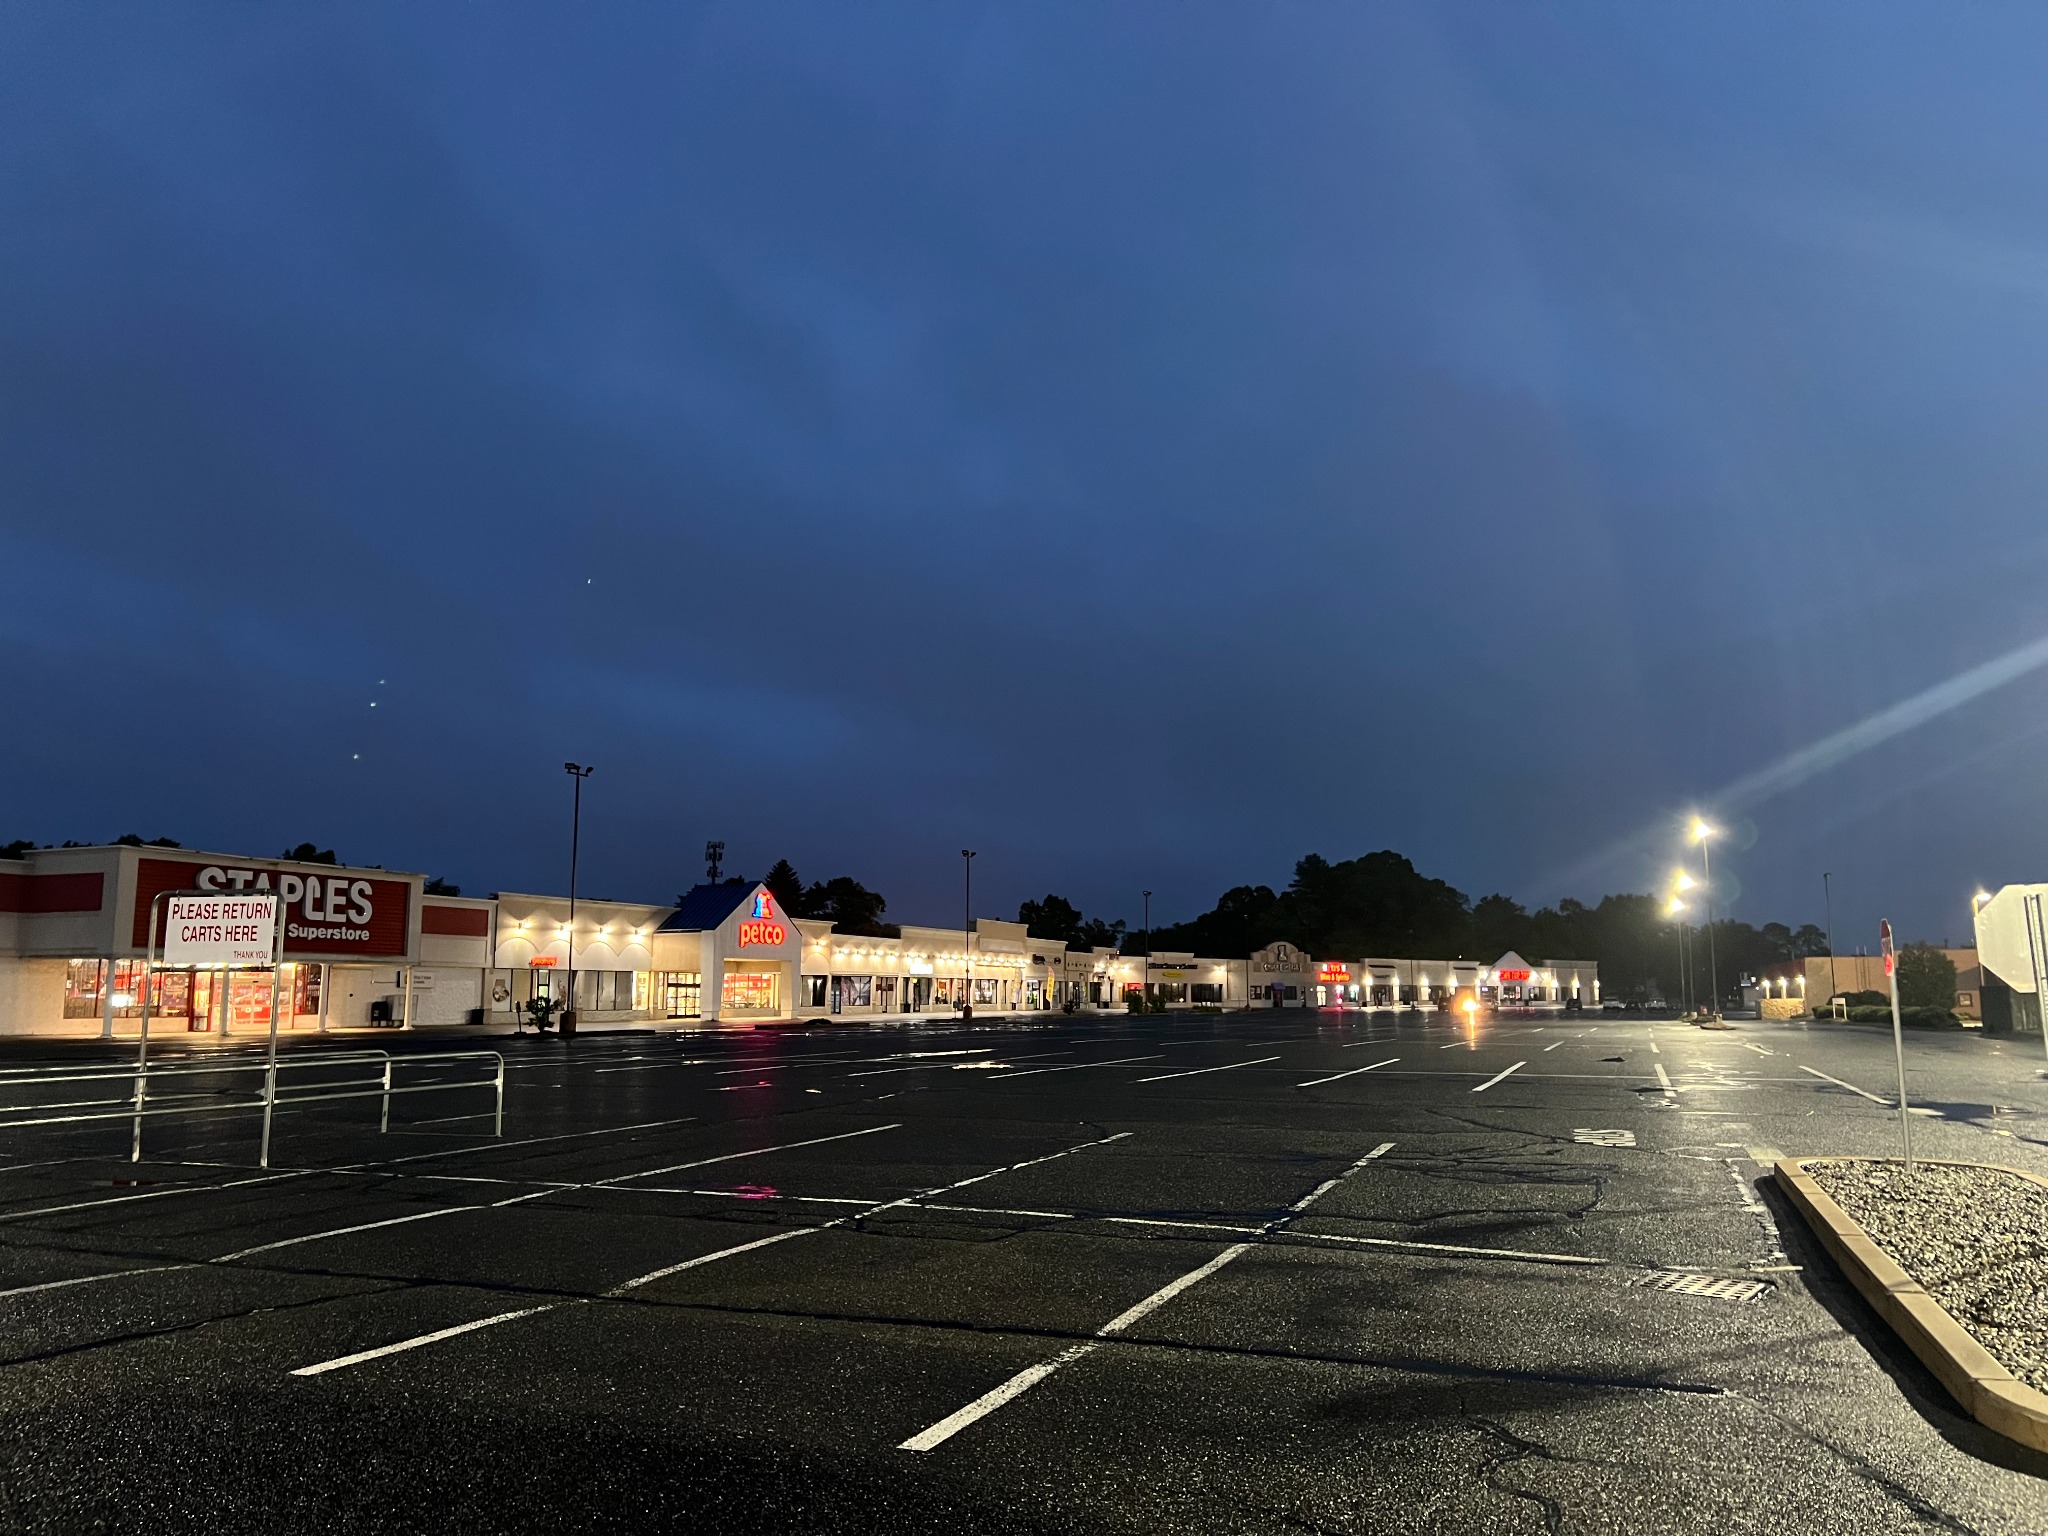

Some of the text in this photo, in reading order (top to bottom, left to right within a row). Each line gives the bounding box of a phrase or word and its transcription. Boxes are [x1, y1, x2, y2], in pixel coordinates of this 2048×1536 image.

[172, 902, 272, 920] PLEASE RETURN
[181, 925, 222, 942] CARTS
[225, 925, 258, 942] HERE
[288, 923, 370, 941] Superstore
[739, 921, 784, 948] petco
[233, 950, 268, 959] THANK YOU
